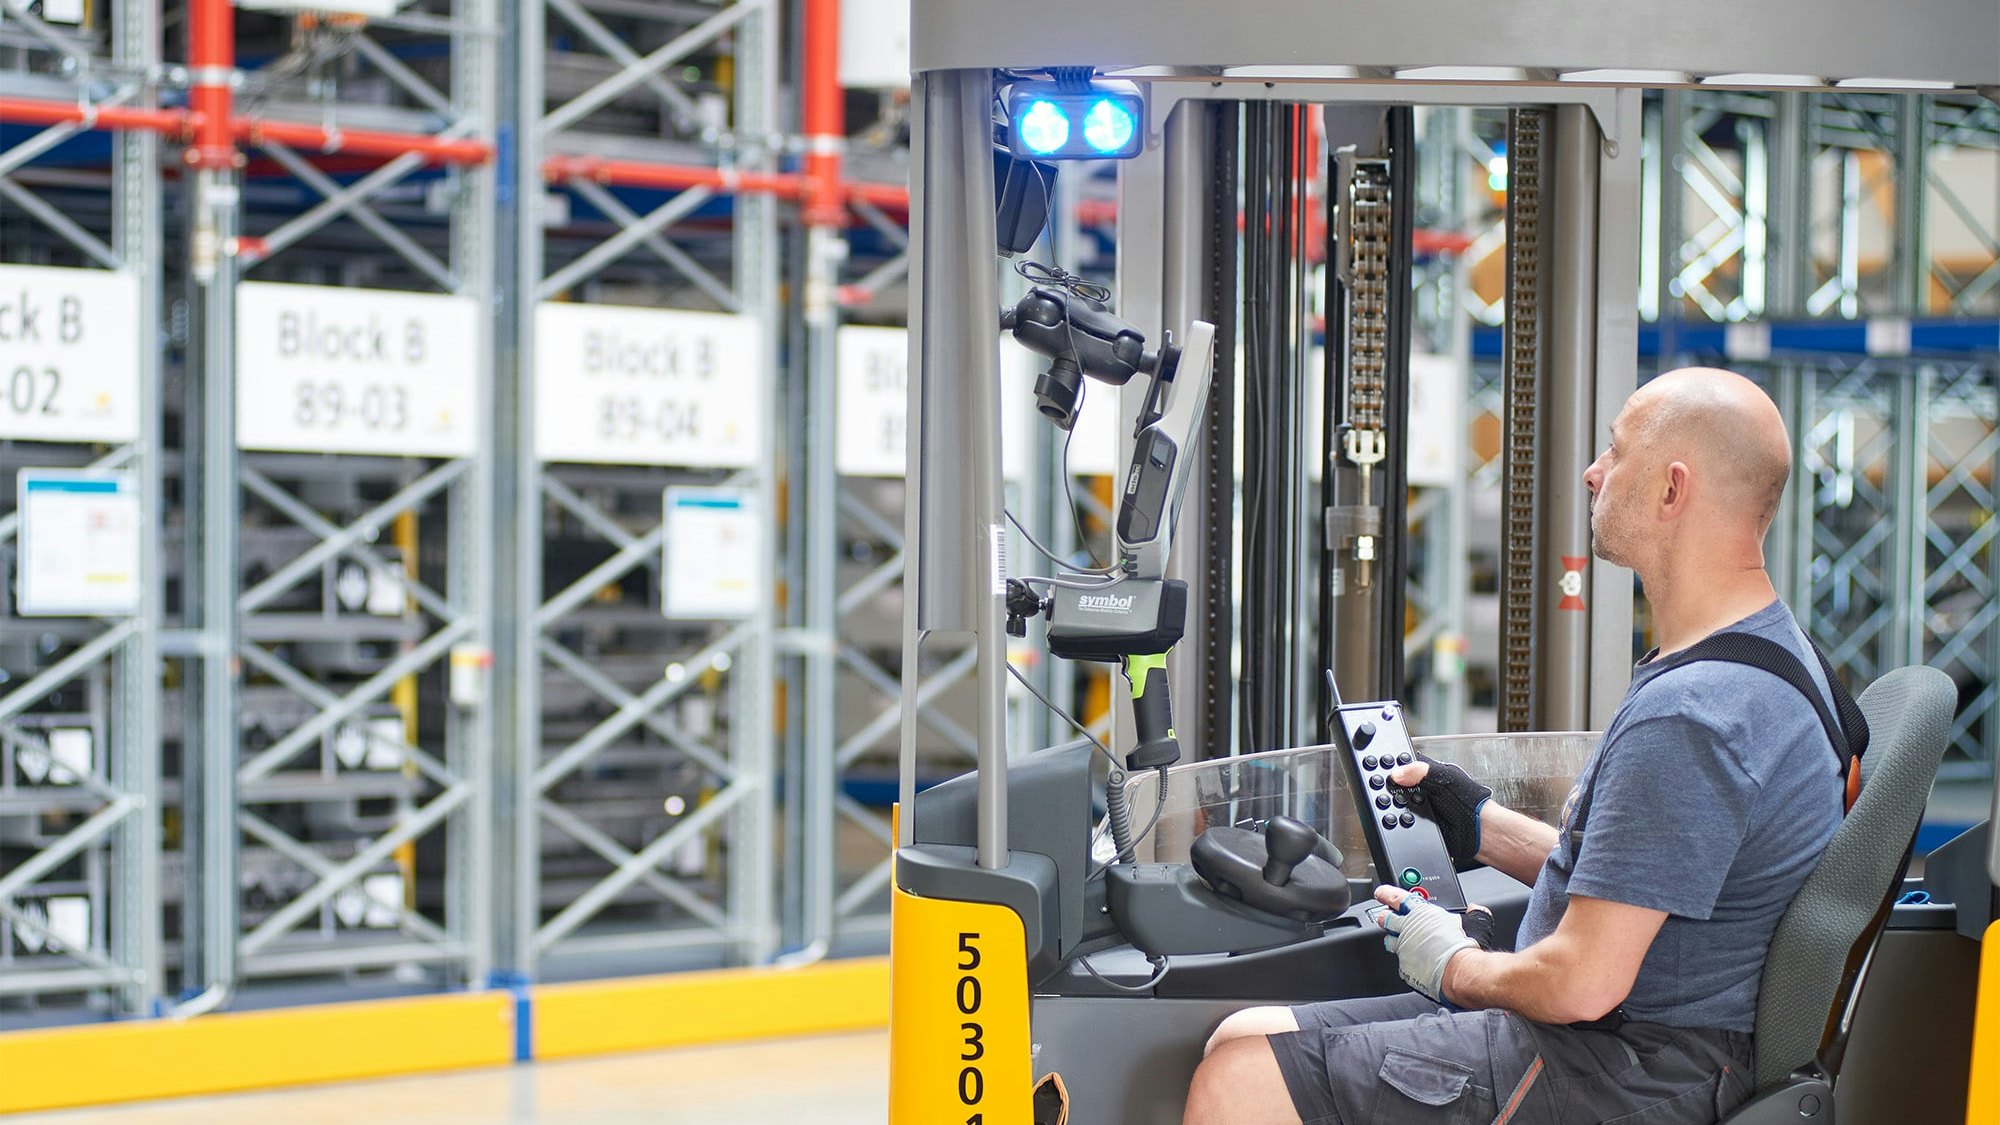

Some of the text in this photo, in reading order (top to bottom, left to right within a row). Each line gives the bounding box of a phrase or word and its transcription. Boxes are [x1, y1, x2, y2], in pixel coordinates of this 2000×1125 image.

[60, 295, 83, 344] B
[277, 309, 427, 366] Block B
[584, 326, 683, 379] Block
[296, 380, 409, 431] 89-03
[599, 395, 702, 442] 89-04
[1080, 594, 1132, 608] symbol
